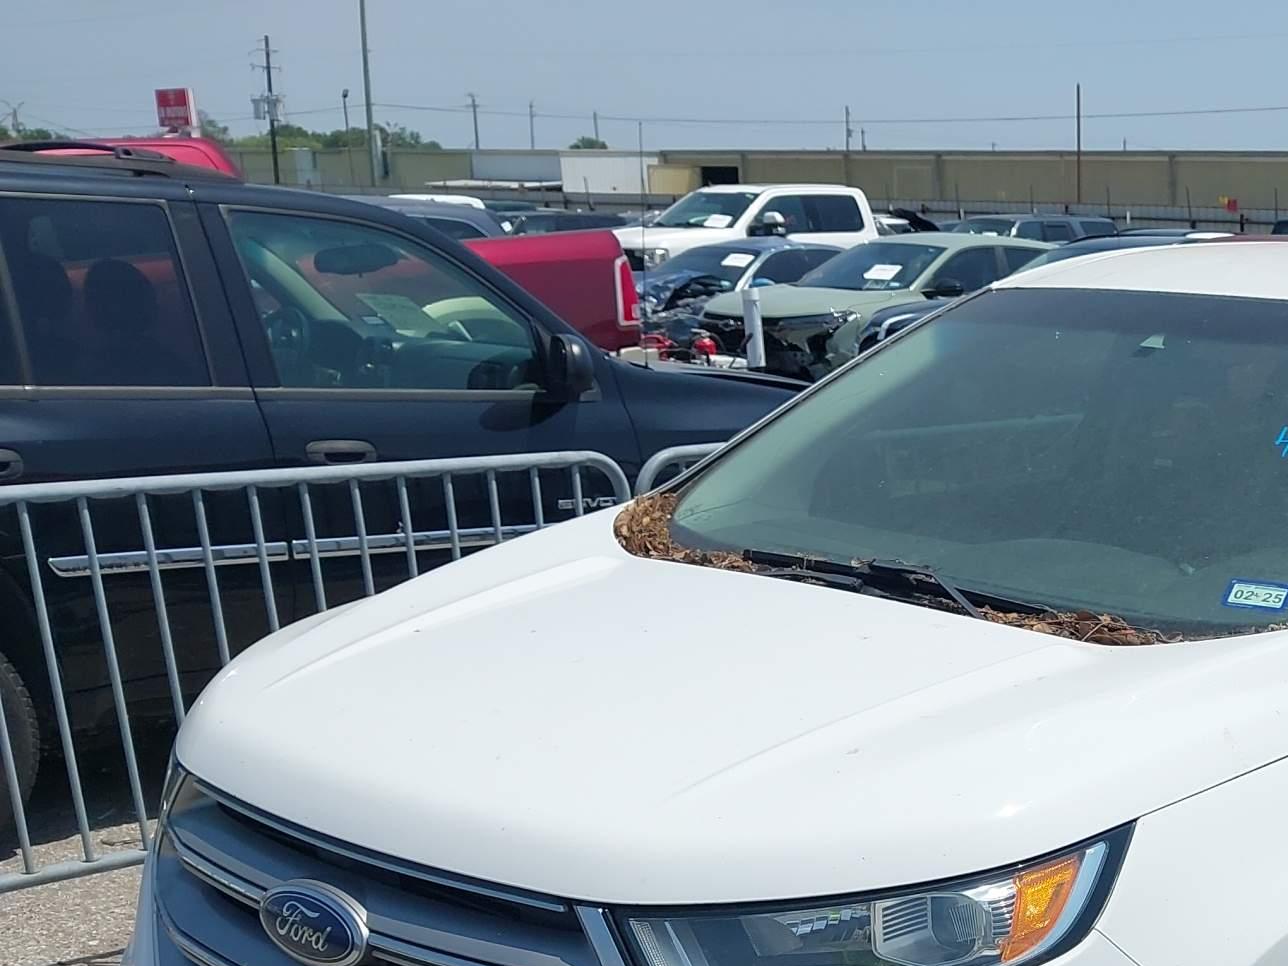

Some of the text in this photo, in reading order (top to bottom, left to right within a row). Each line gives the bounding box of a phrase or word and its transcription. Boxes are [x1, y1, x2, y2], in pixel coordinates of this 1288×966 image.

[1233, 589, 1284, 604] 02 25
[275, 900, 333, 952] Ford
